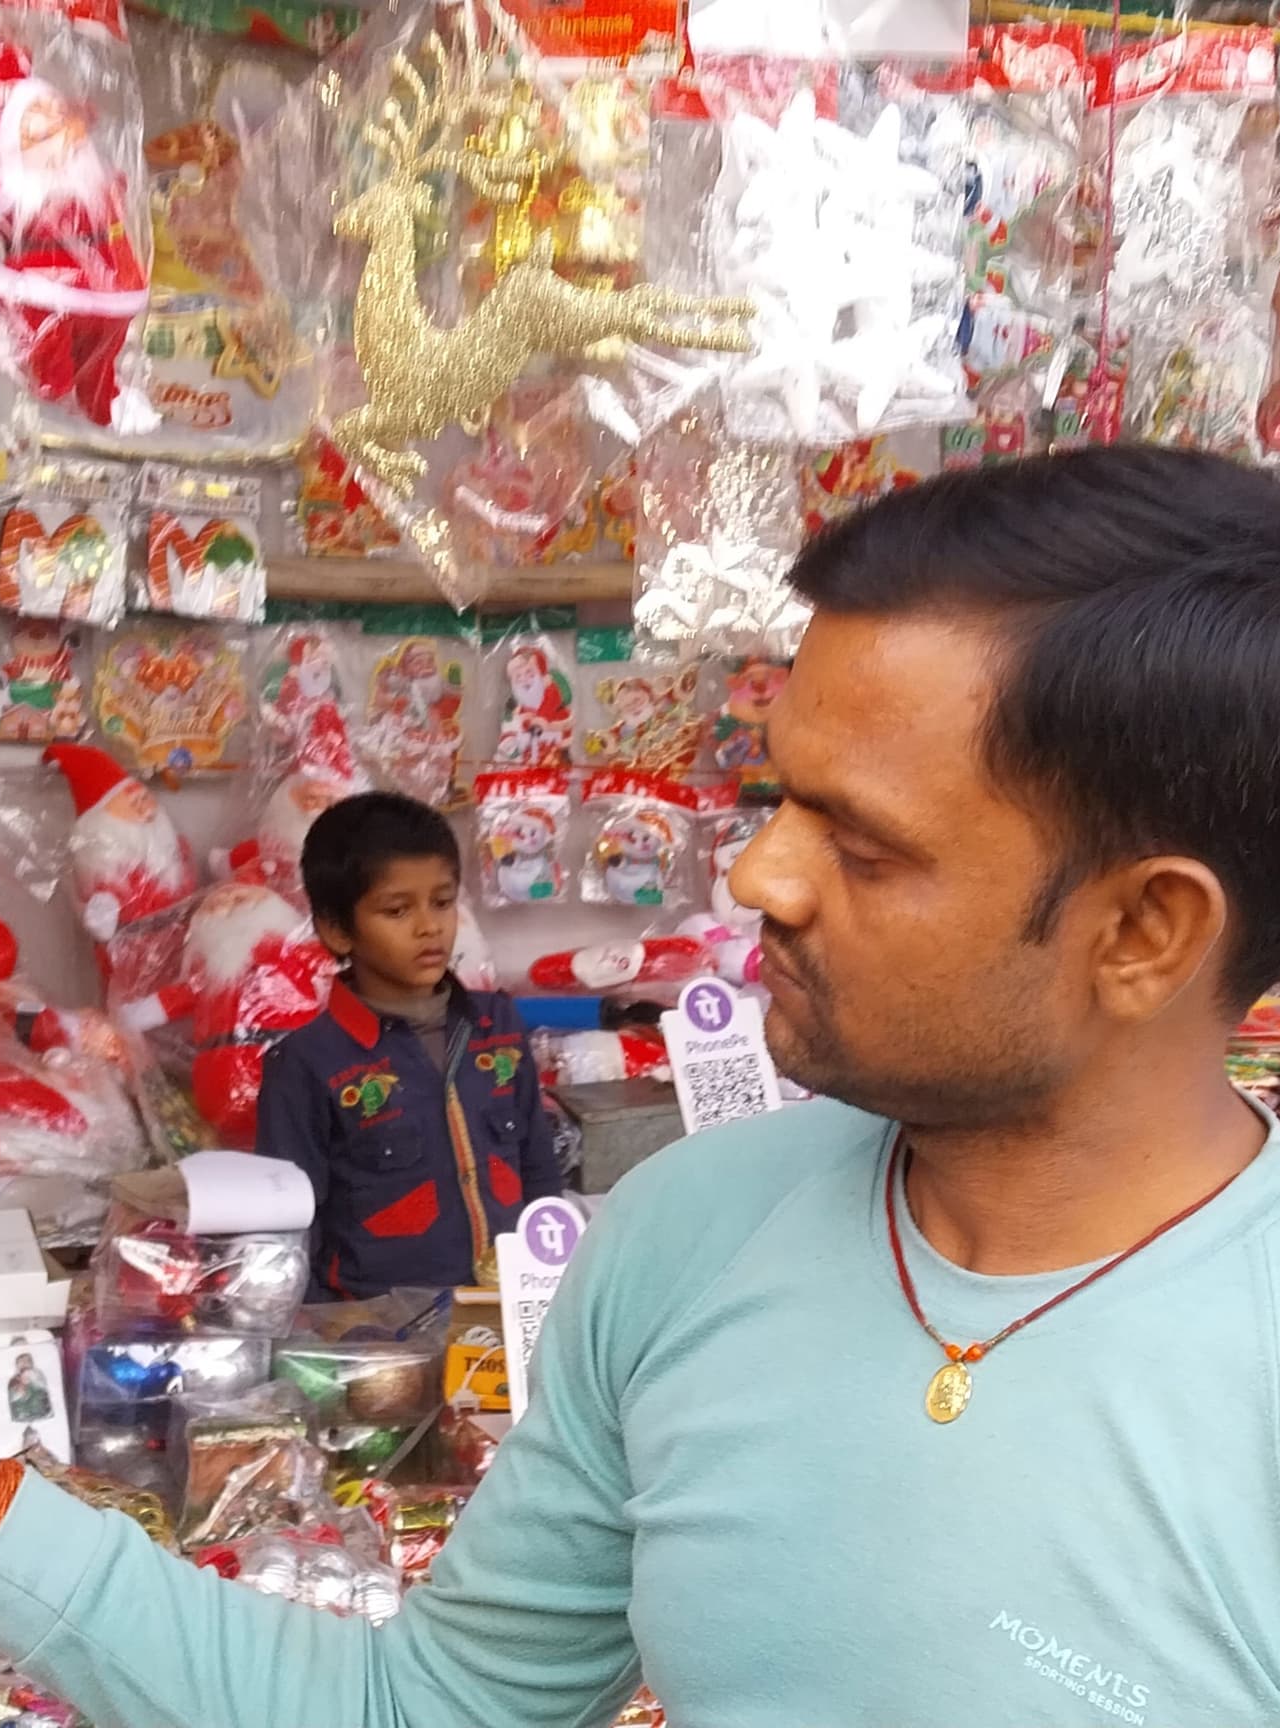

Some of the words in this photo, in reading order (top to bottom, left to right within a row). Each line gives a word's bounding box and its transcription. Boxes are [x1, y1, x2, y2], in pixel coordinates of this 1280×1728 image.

[536, 1213, 566, 1256] पे
[520, 1273, 561, 1290] Phon
[988, 1609, 1151, 1707] MOMENTS
[1024, 1655, 1087, 1696] SPORTING
[1087, 1690, 1145, 1727] SESSION
